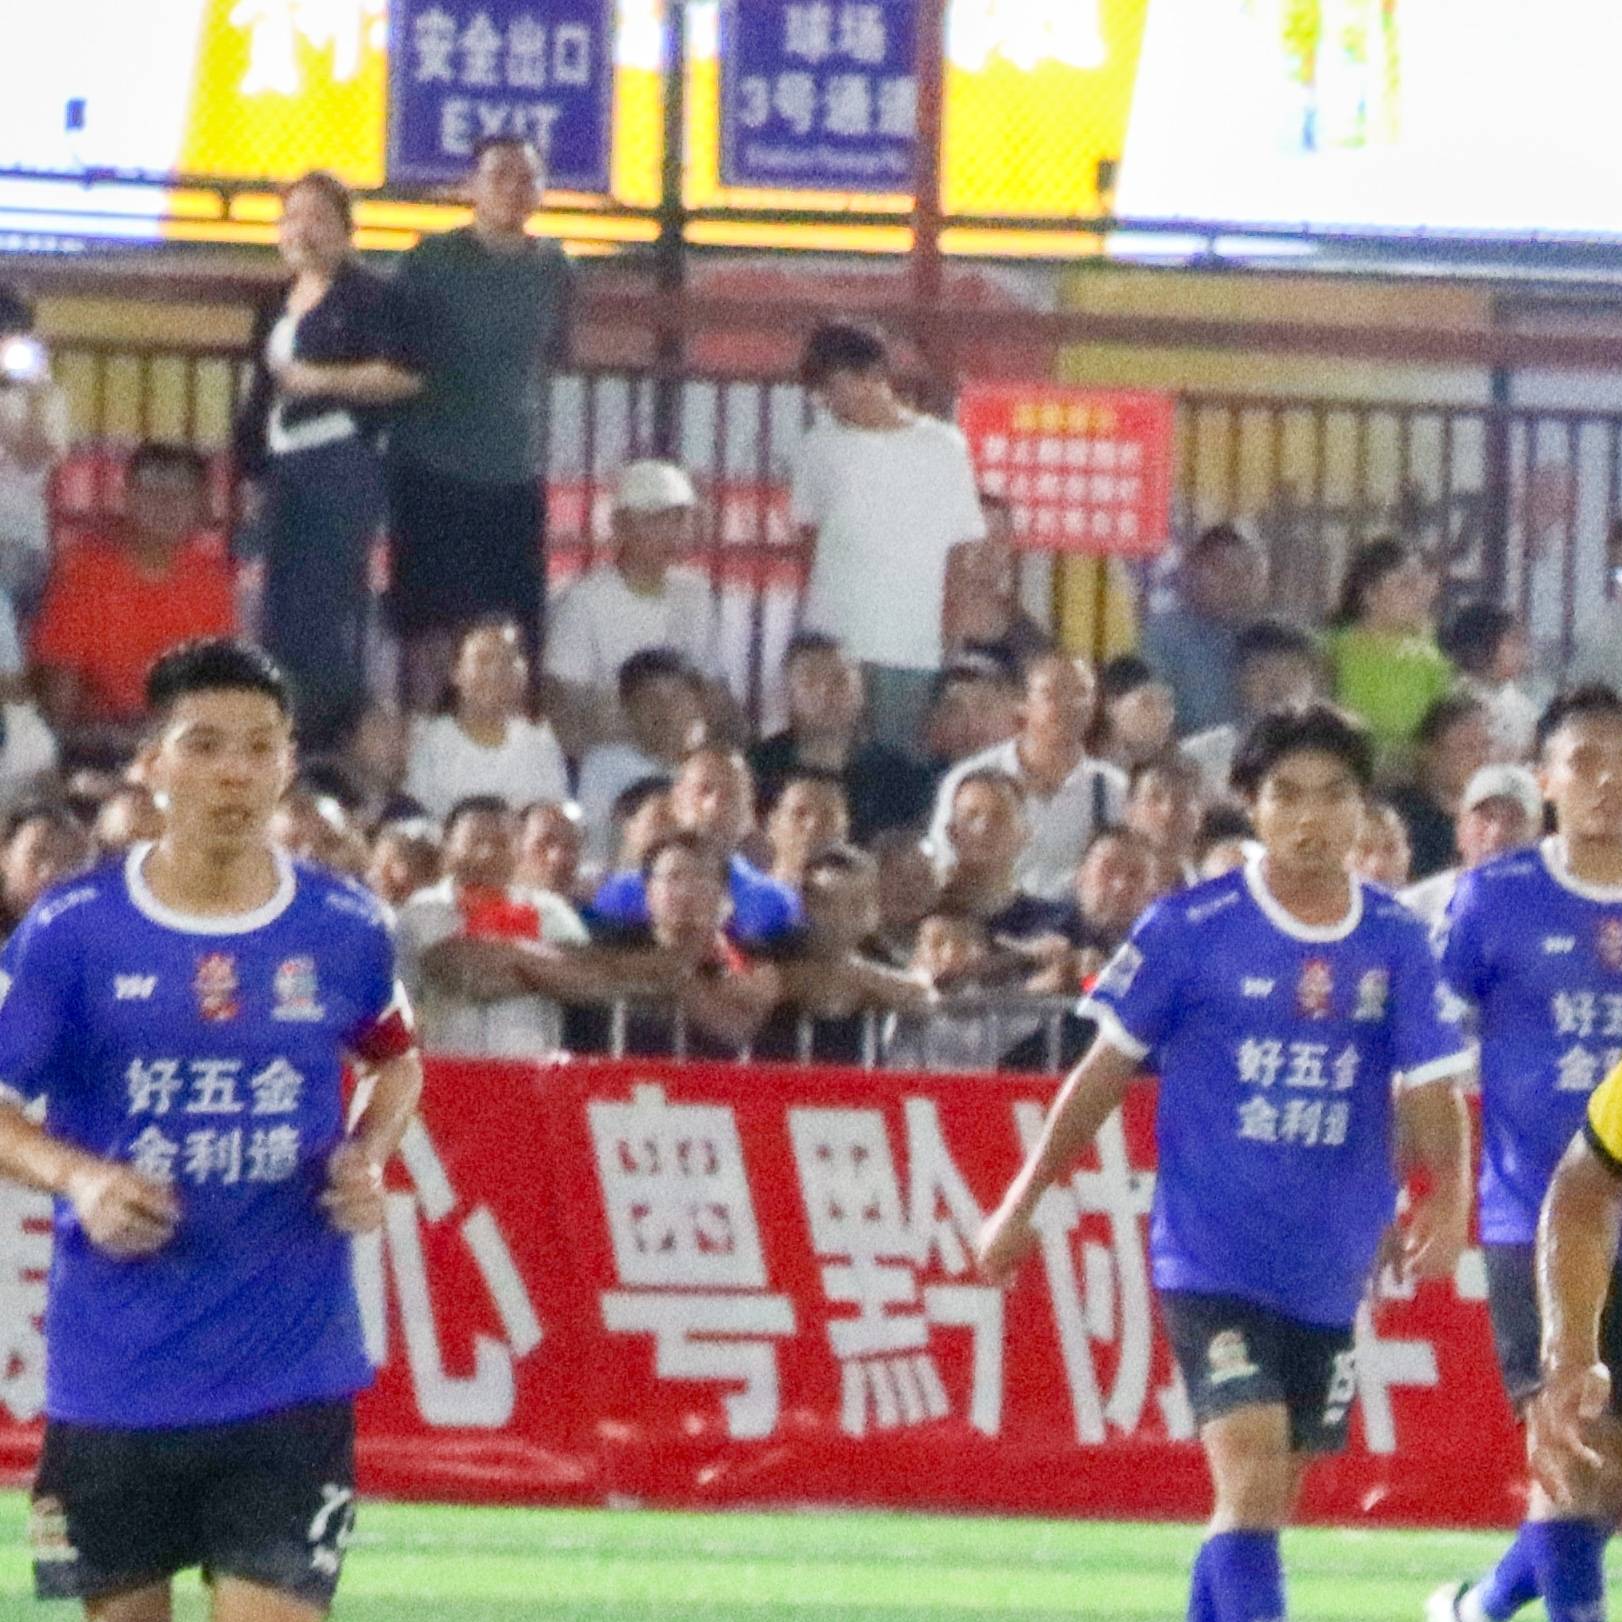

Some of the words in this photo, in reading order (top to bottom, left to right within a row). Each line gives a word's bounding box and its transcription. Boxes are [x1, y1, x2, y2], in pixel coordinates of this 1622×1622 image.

[413, 8, 593, 88] 安全出口
[127, 1057, 304, 1116] 好五金
